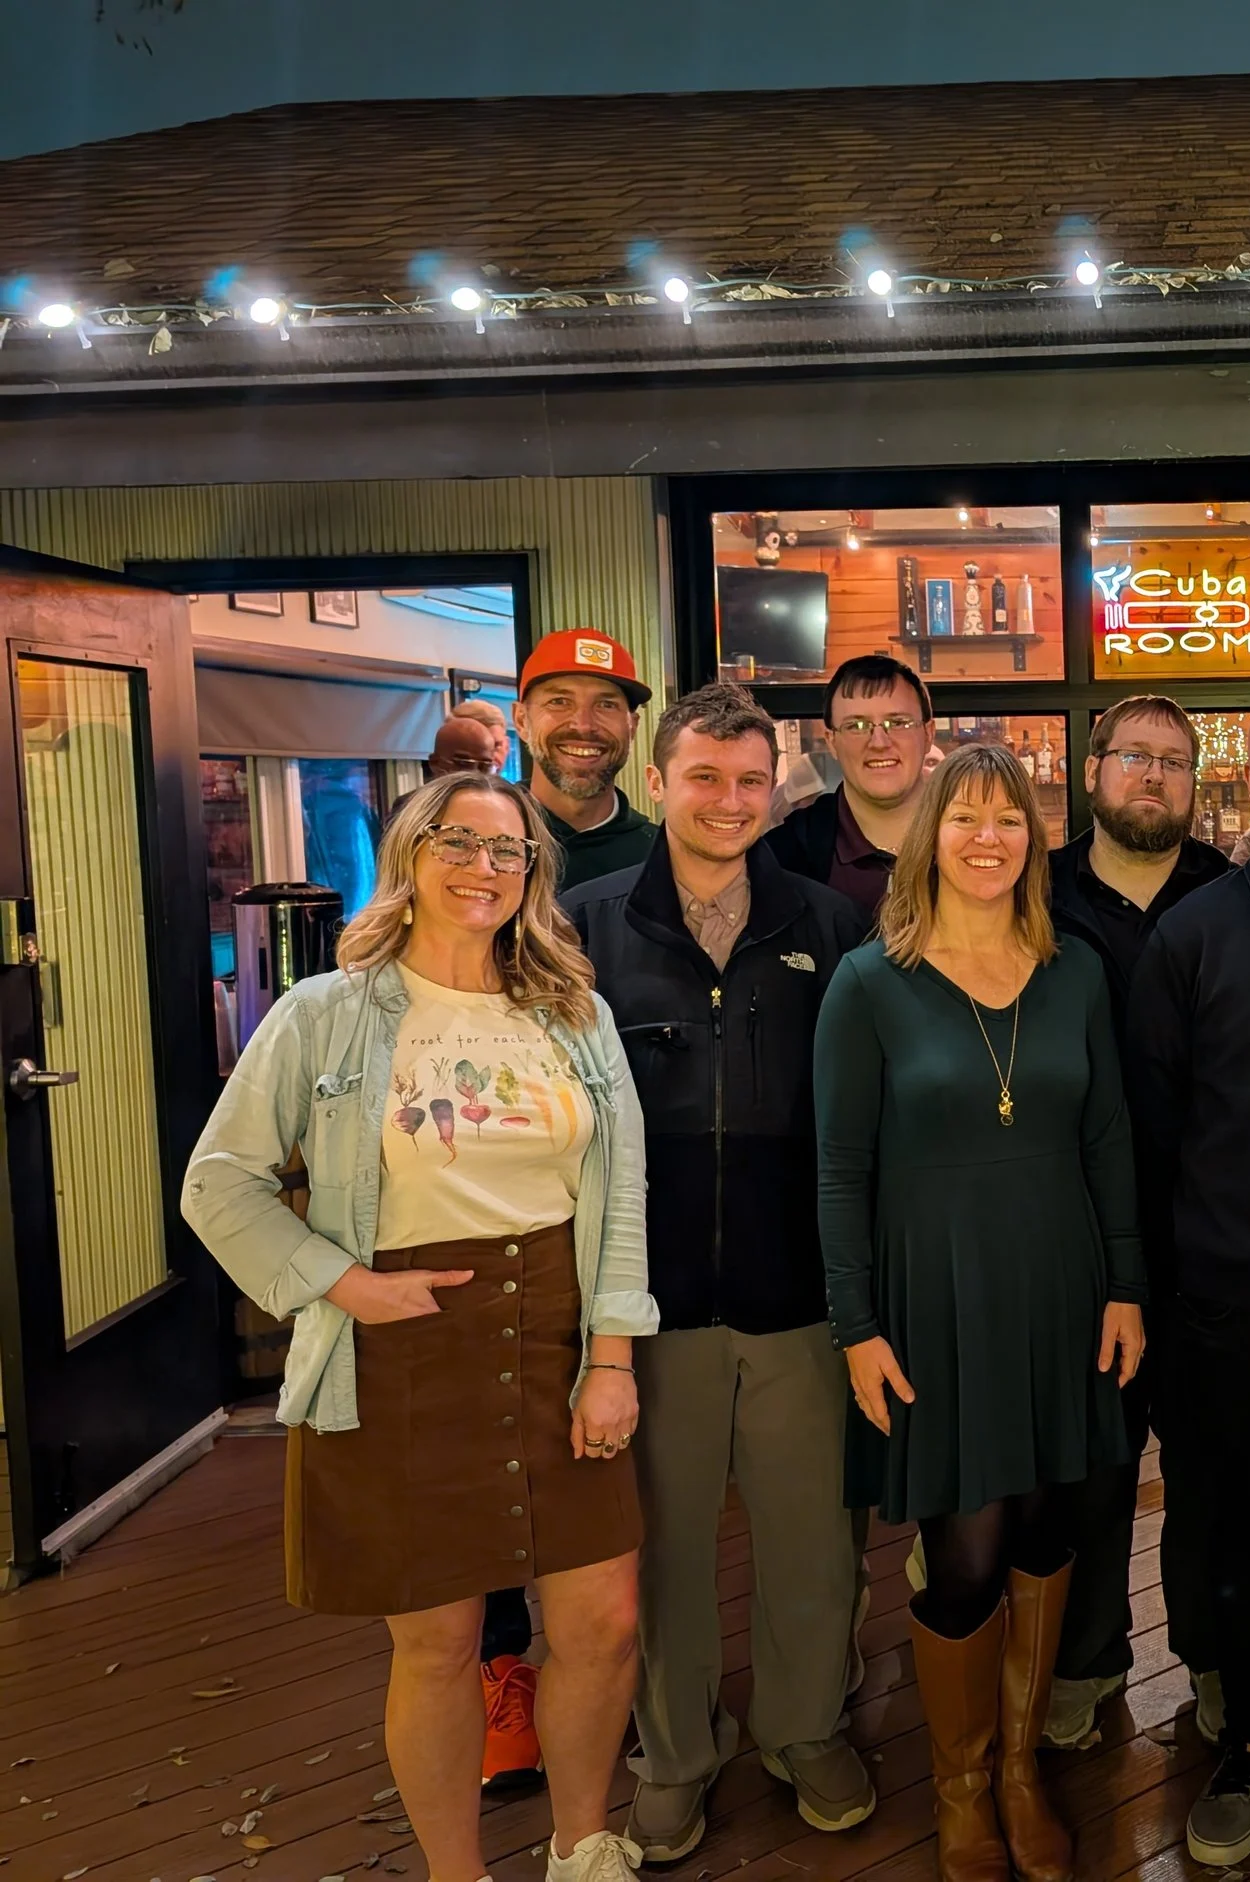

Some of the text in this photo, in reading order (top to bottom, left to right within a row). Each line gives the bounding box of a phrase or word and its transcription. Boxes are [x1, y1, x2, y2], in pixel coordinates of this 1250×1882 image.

[1129, 568, 1247, 597] Cuba
[411, 1033, 443, 1046] root
[456, 1034, 480, 1049] for
[493, 1033, 525, 1044] each
